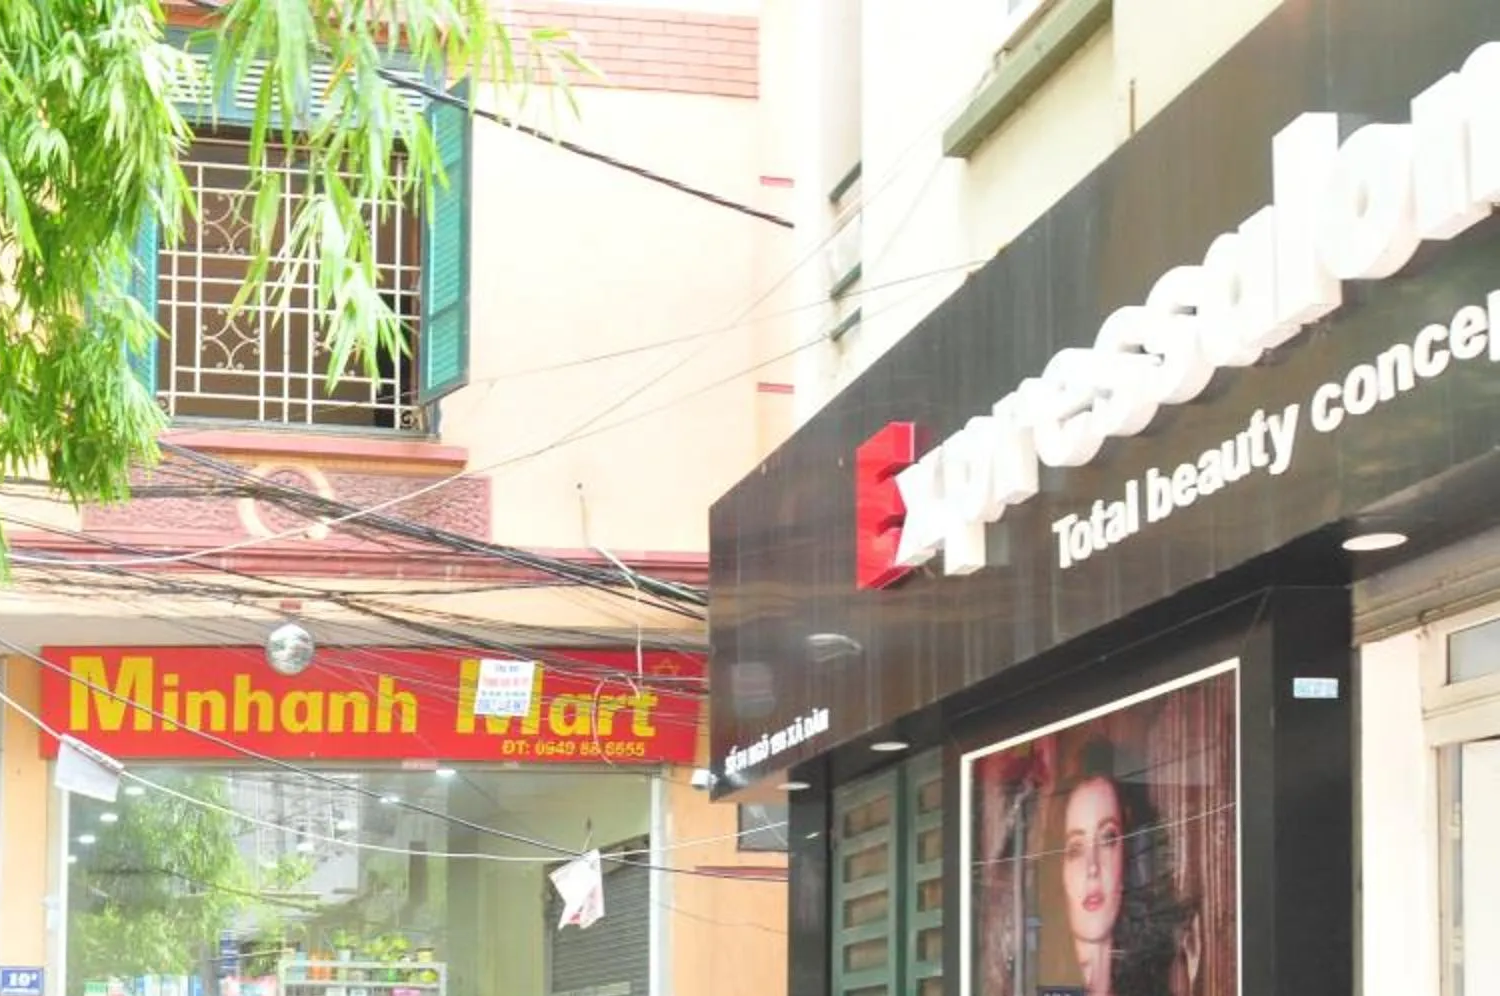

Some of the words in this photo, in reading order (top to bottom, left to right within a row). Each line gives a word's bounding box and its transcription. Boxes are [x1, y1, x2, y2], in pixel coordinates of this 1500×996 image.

[1052, 477, 1140, 569] Total
[1146, 400, 1299, 523] beauty
[1311, 289, 1500, 433] conce
[69, 656, 418, 733] Minhanh
[456, 657, 659, 738] Mart
